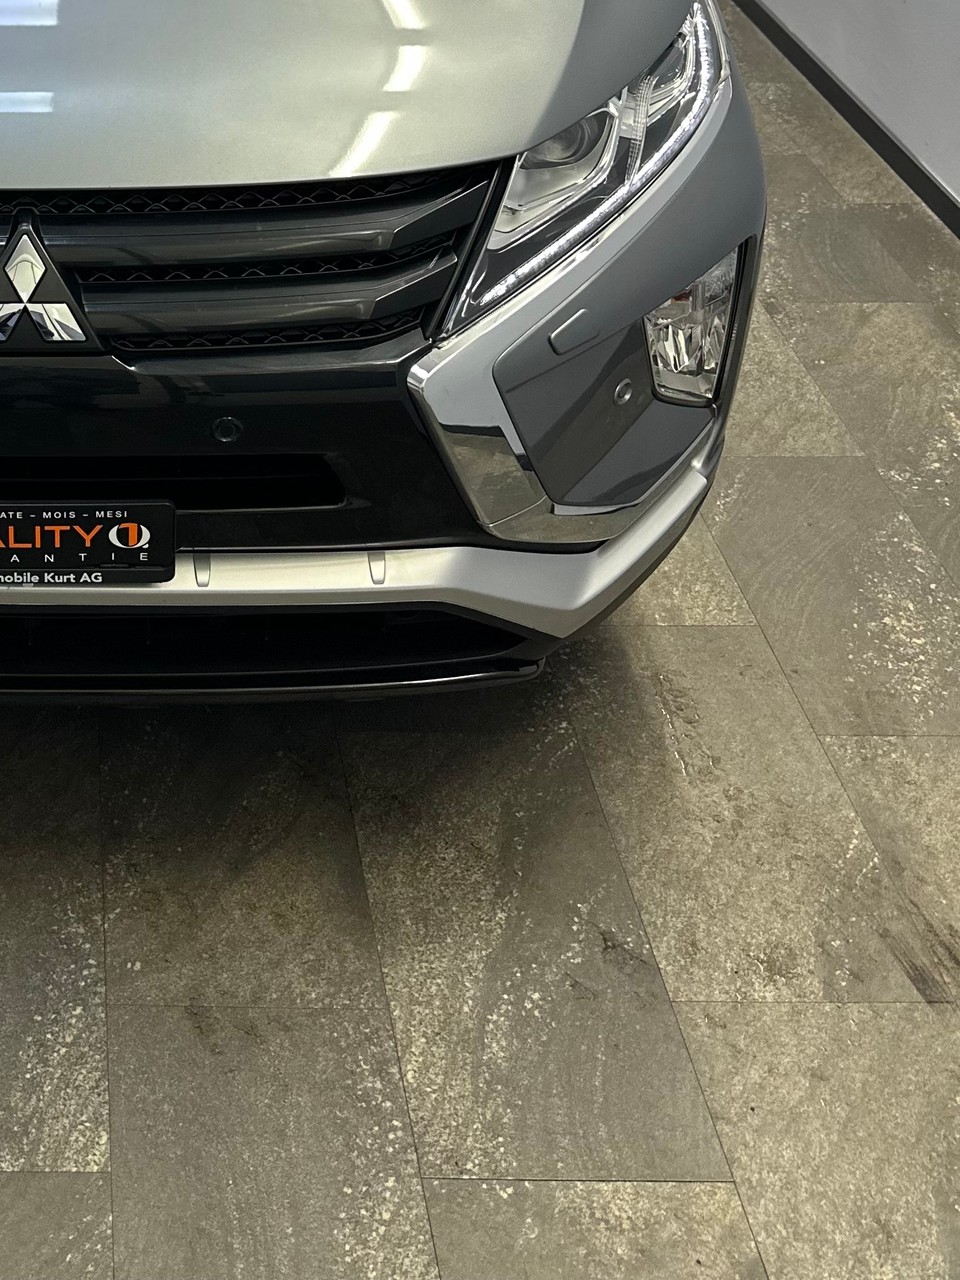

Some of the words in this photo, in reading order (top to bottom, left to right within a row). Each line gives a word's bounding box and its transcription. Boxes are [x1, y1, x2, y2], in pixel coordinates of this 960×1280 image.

[43, 511, 76, 519] MOIS
[95, 510, 128, 518] MESI
[44, 572, 76, 583] Kurt
[79, 572, 103, 583] AG
